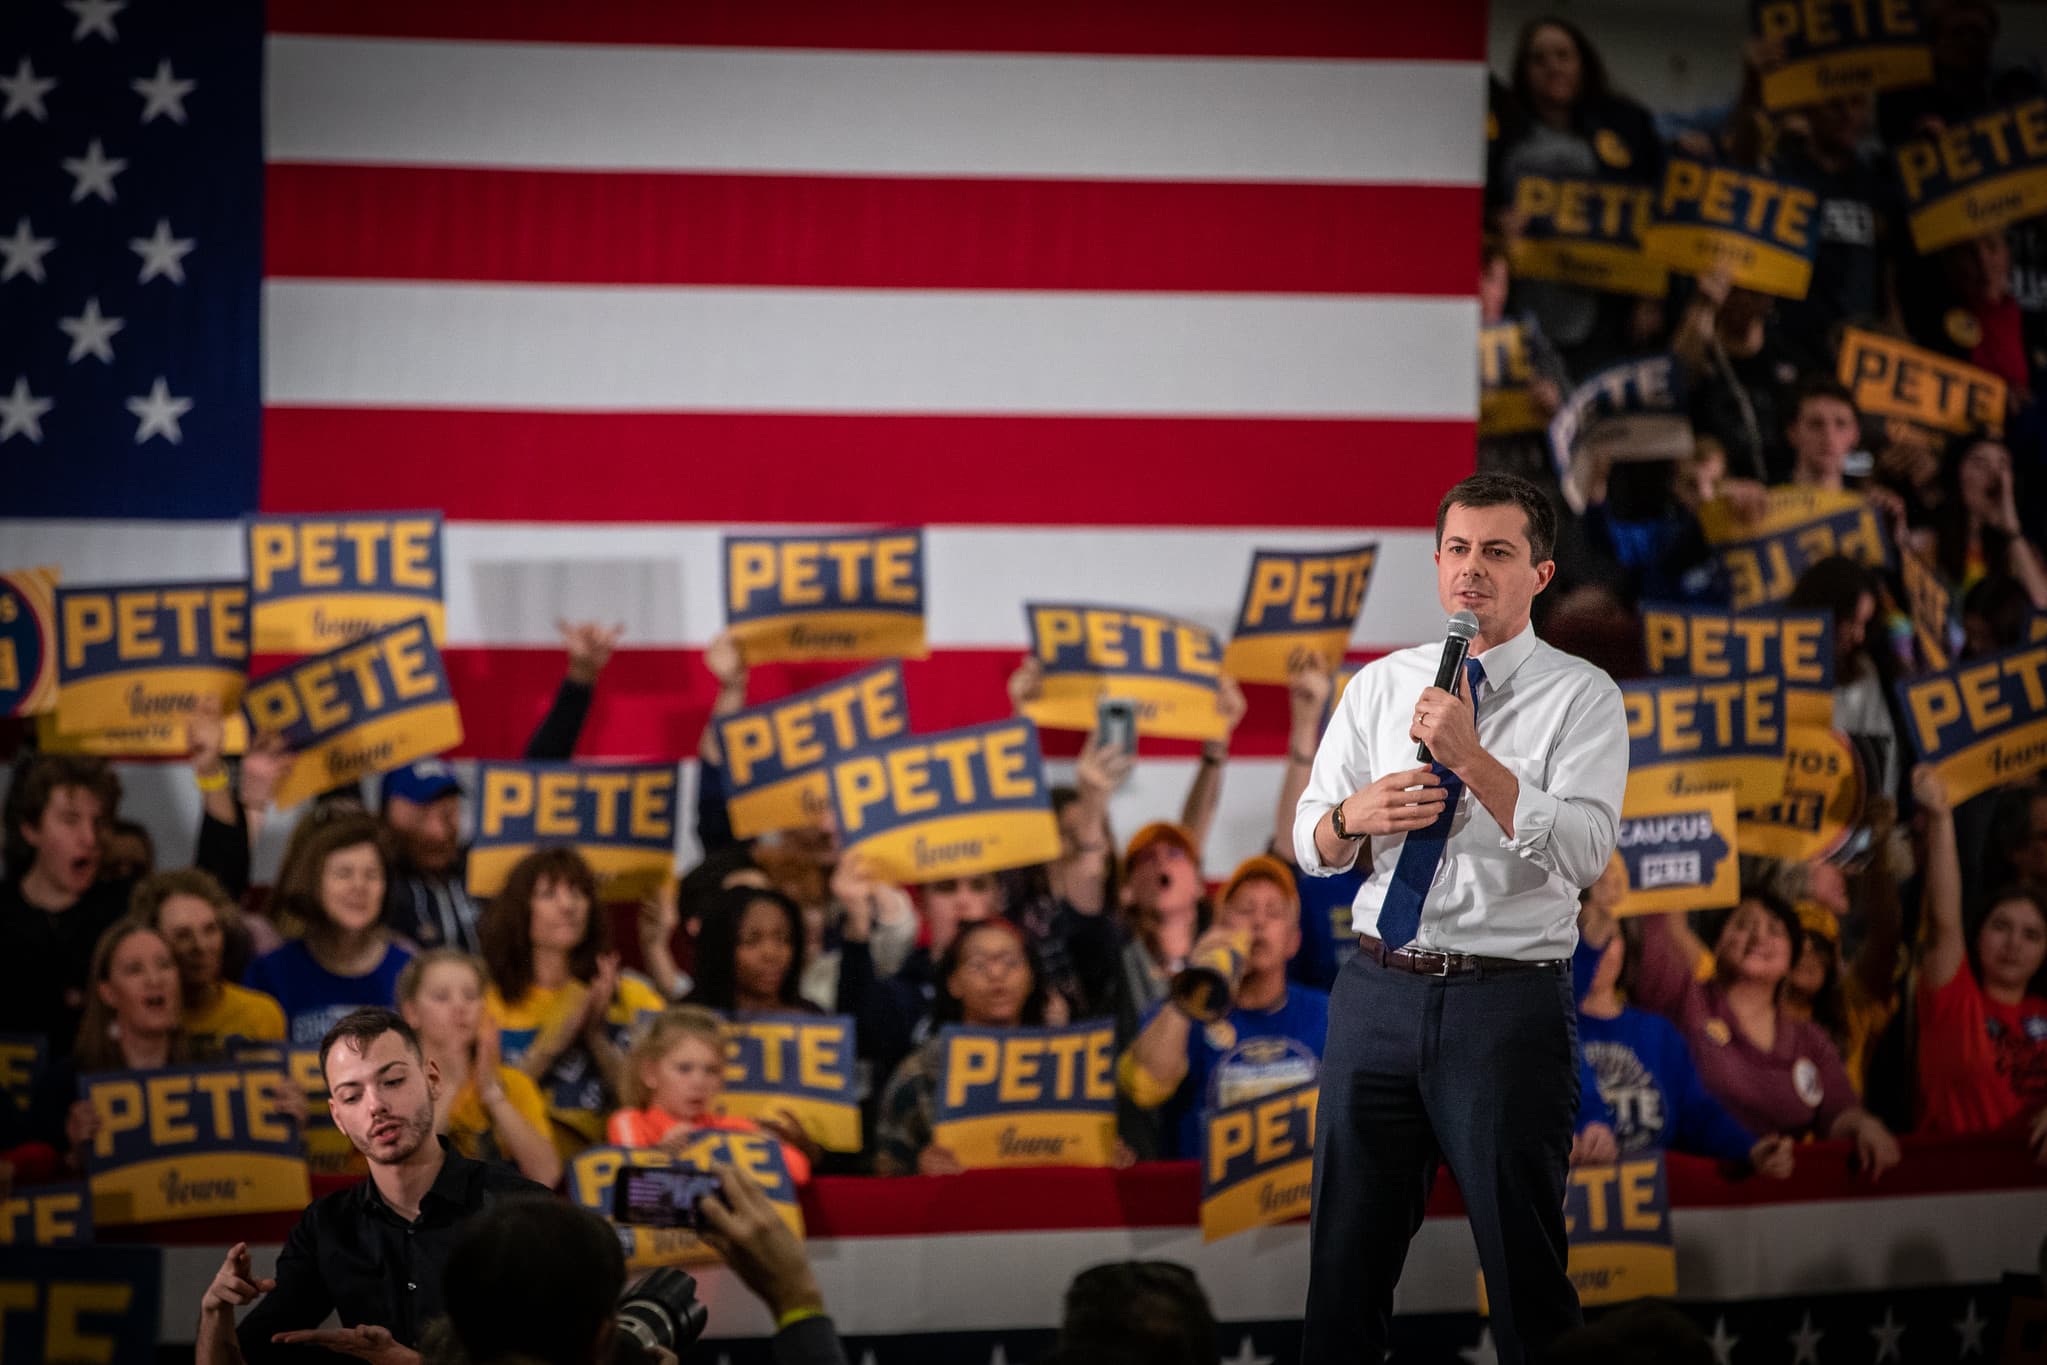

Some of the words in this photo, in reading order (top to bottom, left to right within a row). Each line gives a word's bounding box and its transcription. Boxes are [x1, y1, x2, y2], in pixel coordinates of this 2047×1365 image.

[1660, 159, 1817, 248] PETE
[1850, 350, 1994, 424] PETE
[252, 519, 437, 593] PETE
[729, 536, 917, 612] PETE
[1245, 551, 1373, 627] PETE
[64, 587, 246, 670] PETE
[1035, 608, 1220, 677] PETE
[1643, 612, 1825, 684] PETE
[245, 621, 438, 734] PETE
[1624, 678, 1779, 753] PETE
[721, 668, 905, 788] PETE
[482, 769, 677, 838] PETE
[834, 727, 1036, 832] PETE
[1617, 812, 1711, 848] CAUCUS
[1647, 860, 1693, 879] PETE
[721, 1022, 846, 1089] ETE
[946, 1028, 1116, 1108] PETE
[90, 1071, 291, 1157] PETE
[1208, 1086, 1320, 1186] PET
[573, 1134, 782, 1206] PTE
[1567, 1158, 1663, 1234] TE
